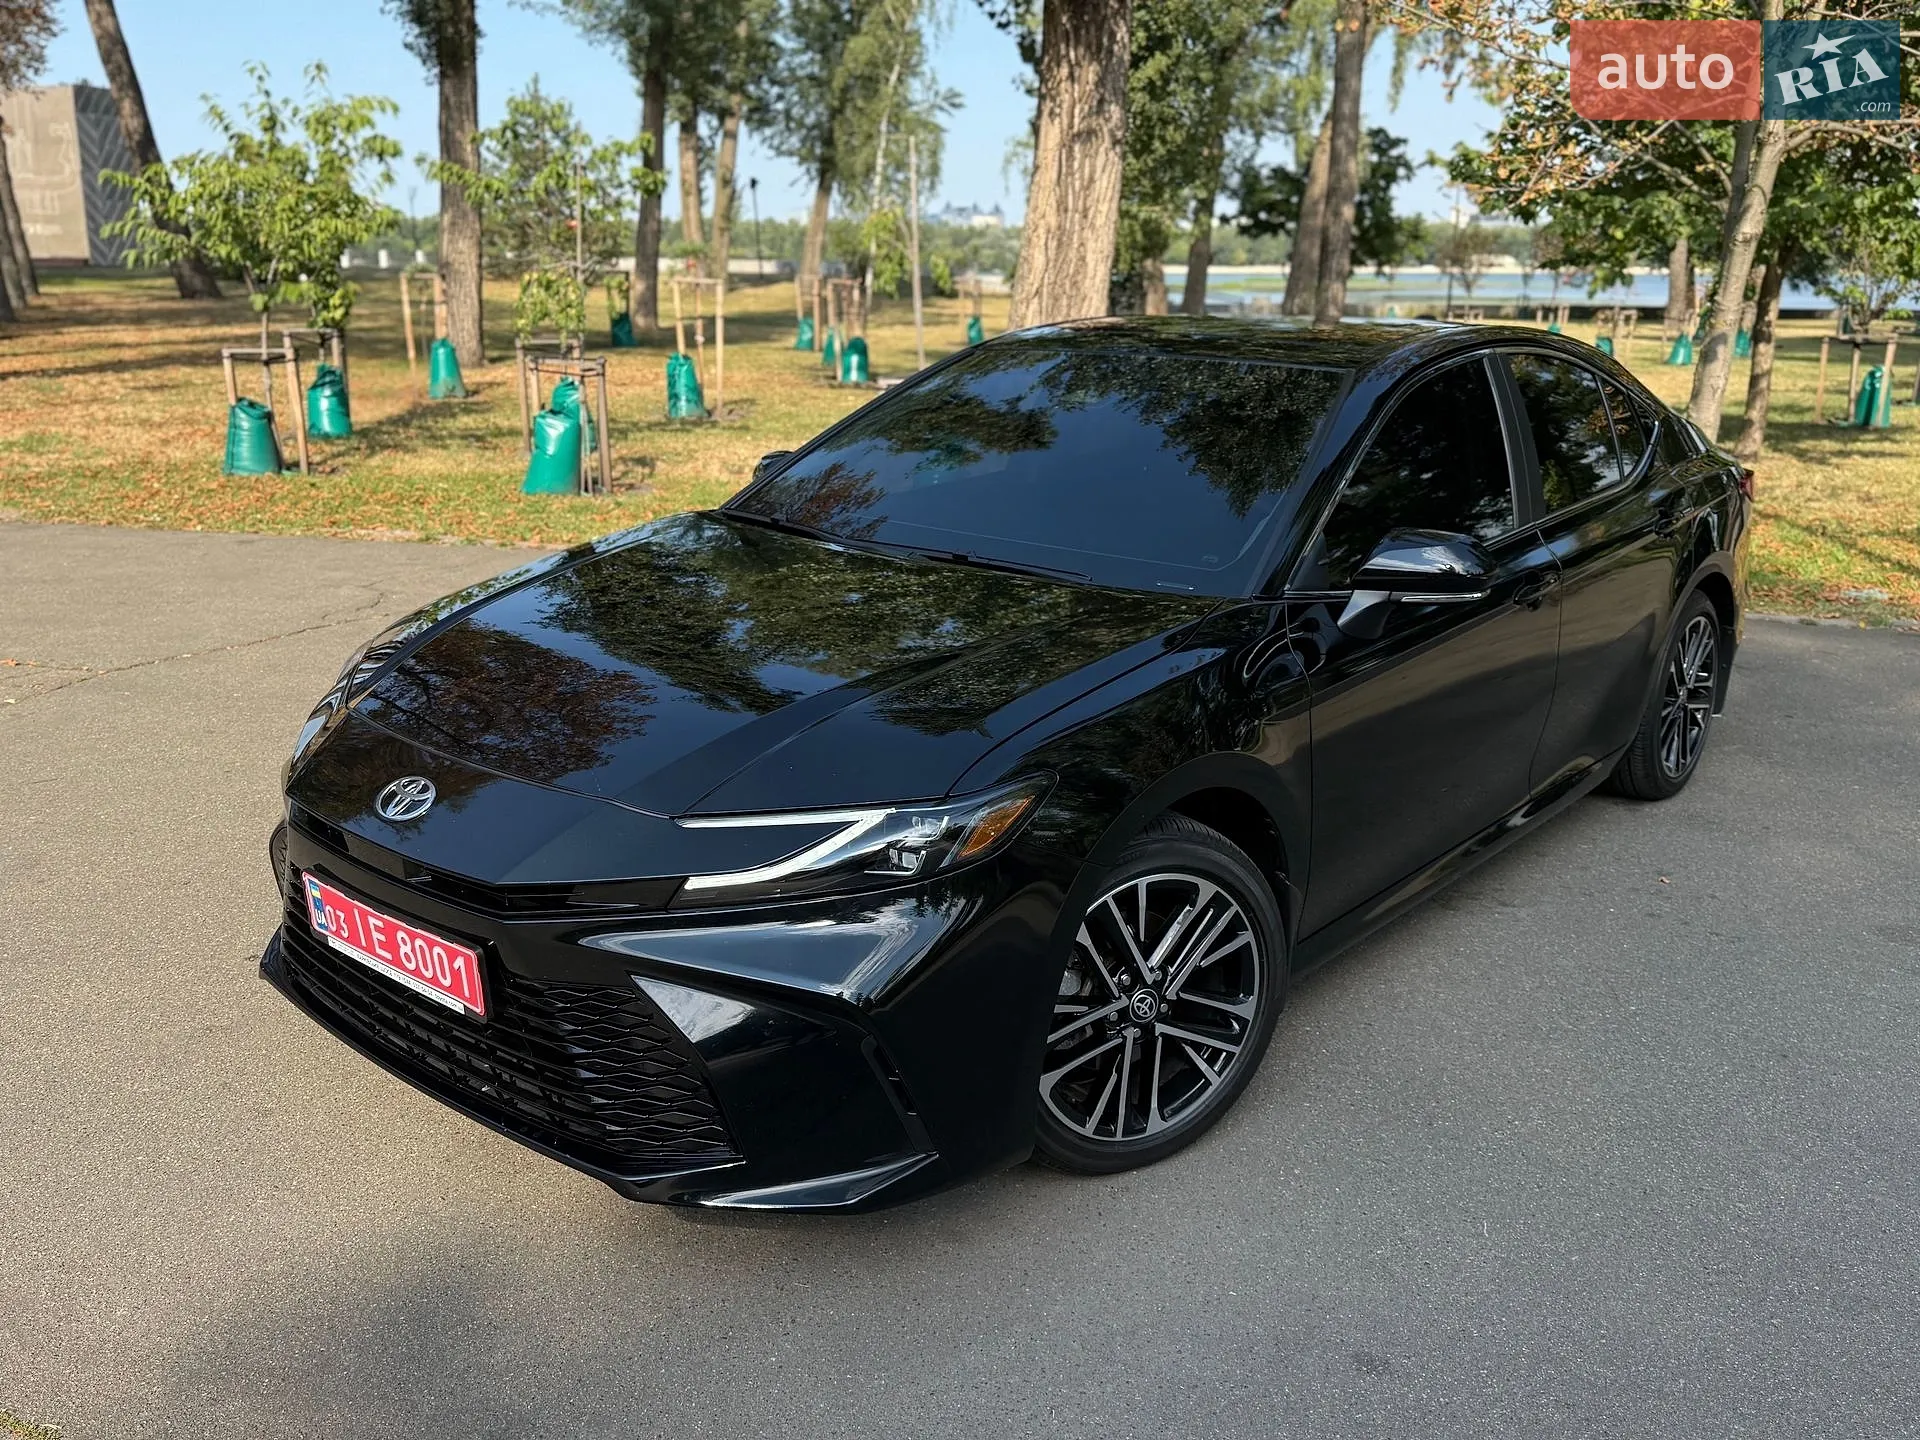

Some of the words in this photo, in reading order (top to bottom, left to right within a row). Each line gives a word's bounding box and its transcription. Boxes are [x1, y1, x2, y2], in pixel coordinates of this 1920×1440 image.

[315, 909, 328, 926] UA
[326, 904, 349, 939] 03
[396, 930, 471, 999] 8001
